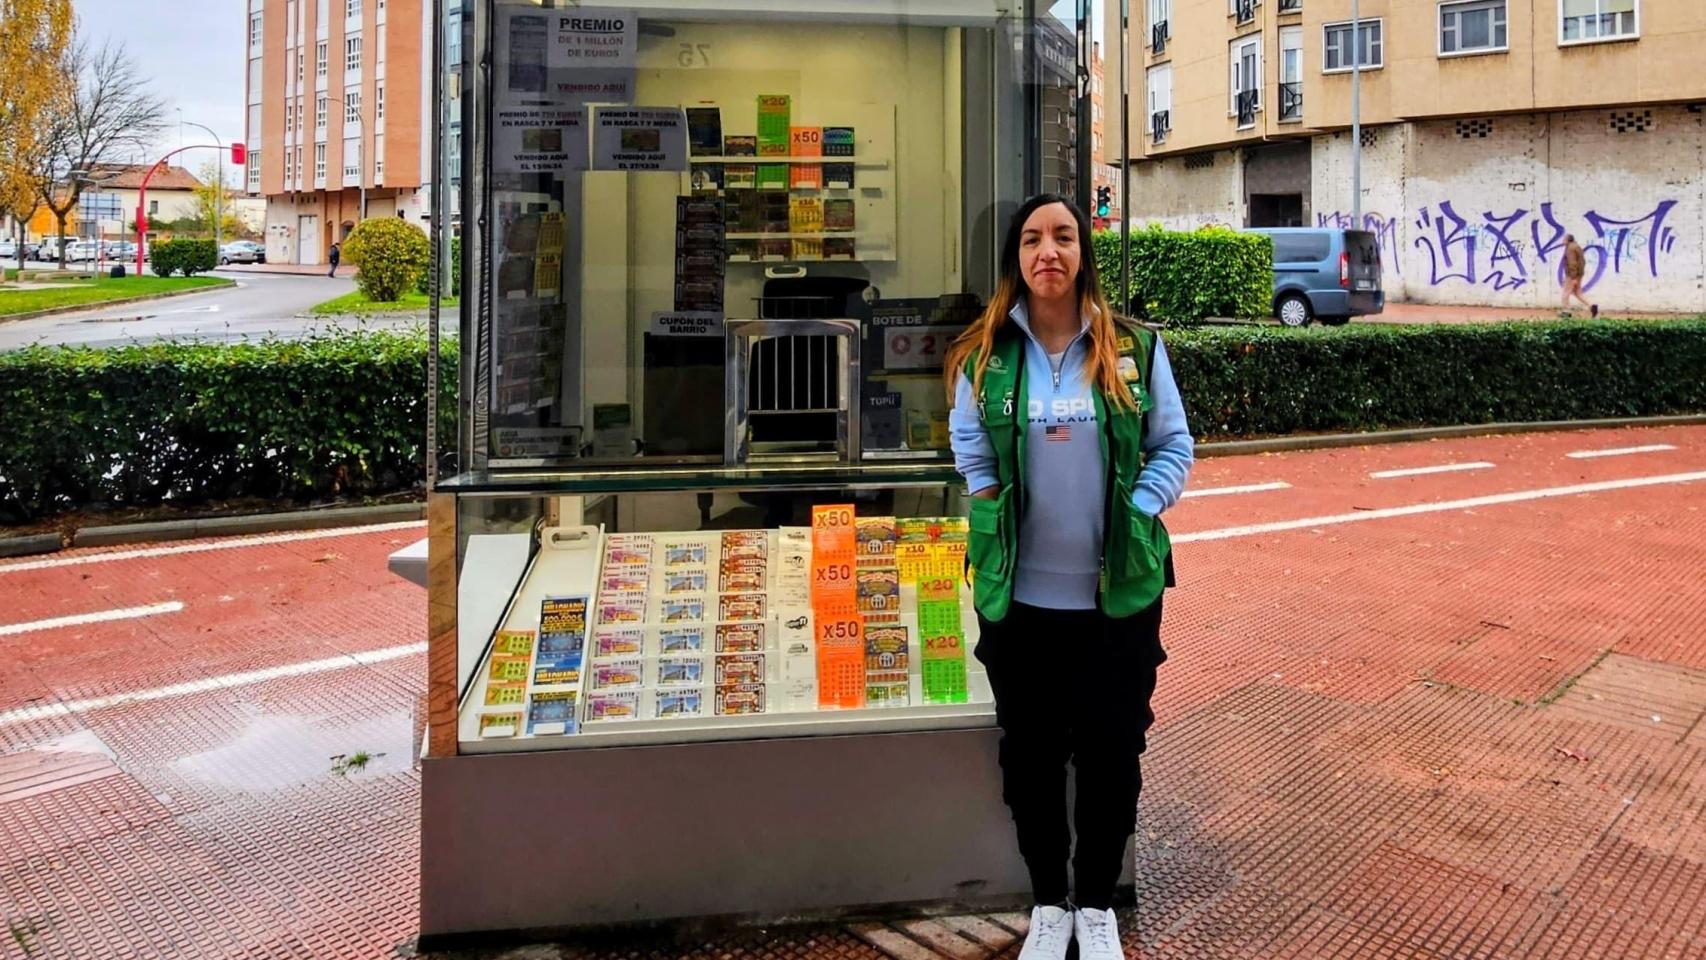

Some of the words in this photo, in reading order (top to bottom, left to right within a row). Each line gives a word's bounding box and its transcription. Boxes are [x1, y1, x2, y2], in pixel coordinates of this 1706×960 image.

[560, 18, 624, 31] PREMIO
[558, 36, 572, 44] DE
[568, 49, 581, 57] DE
[558, 83, 600, 92] VENDIDO
[794, 131, 818, 143] x50
[696, 318, 715, 326] DEL
[873, 316, 905, 326] BOTE
[906, 315, 922, 325] DE
[669, 326, 707, 334] BARRIO
[817, 510, 850, 527] x50
[905, 544, 925, 553] x10
[816, 564, 850, 581] x50
[921, 579, 953, 591] x20
[824, 621, 858, 638] x50
[925, 636, 958, 648] x20
